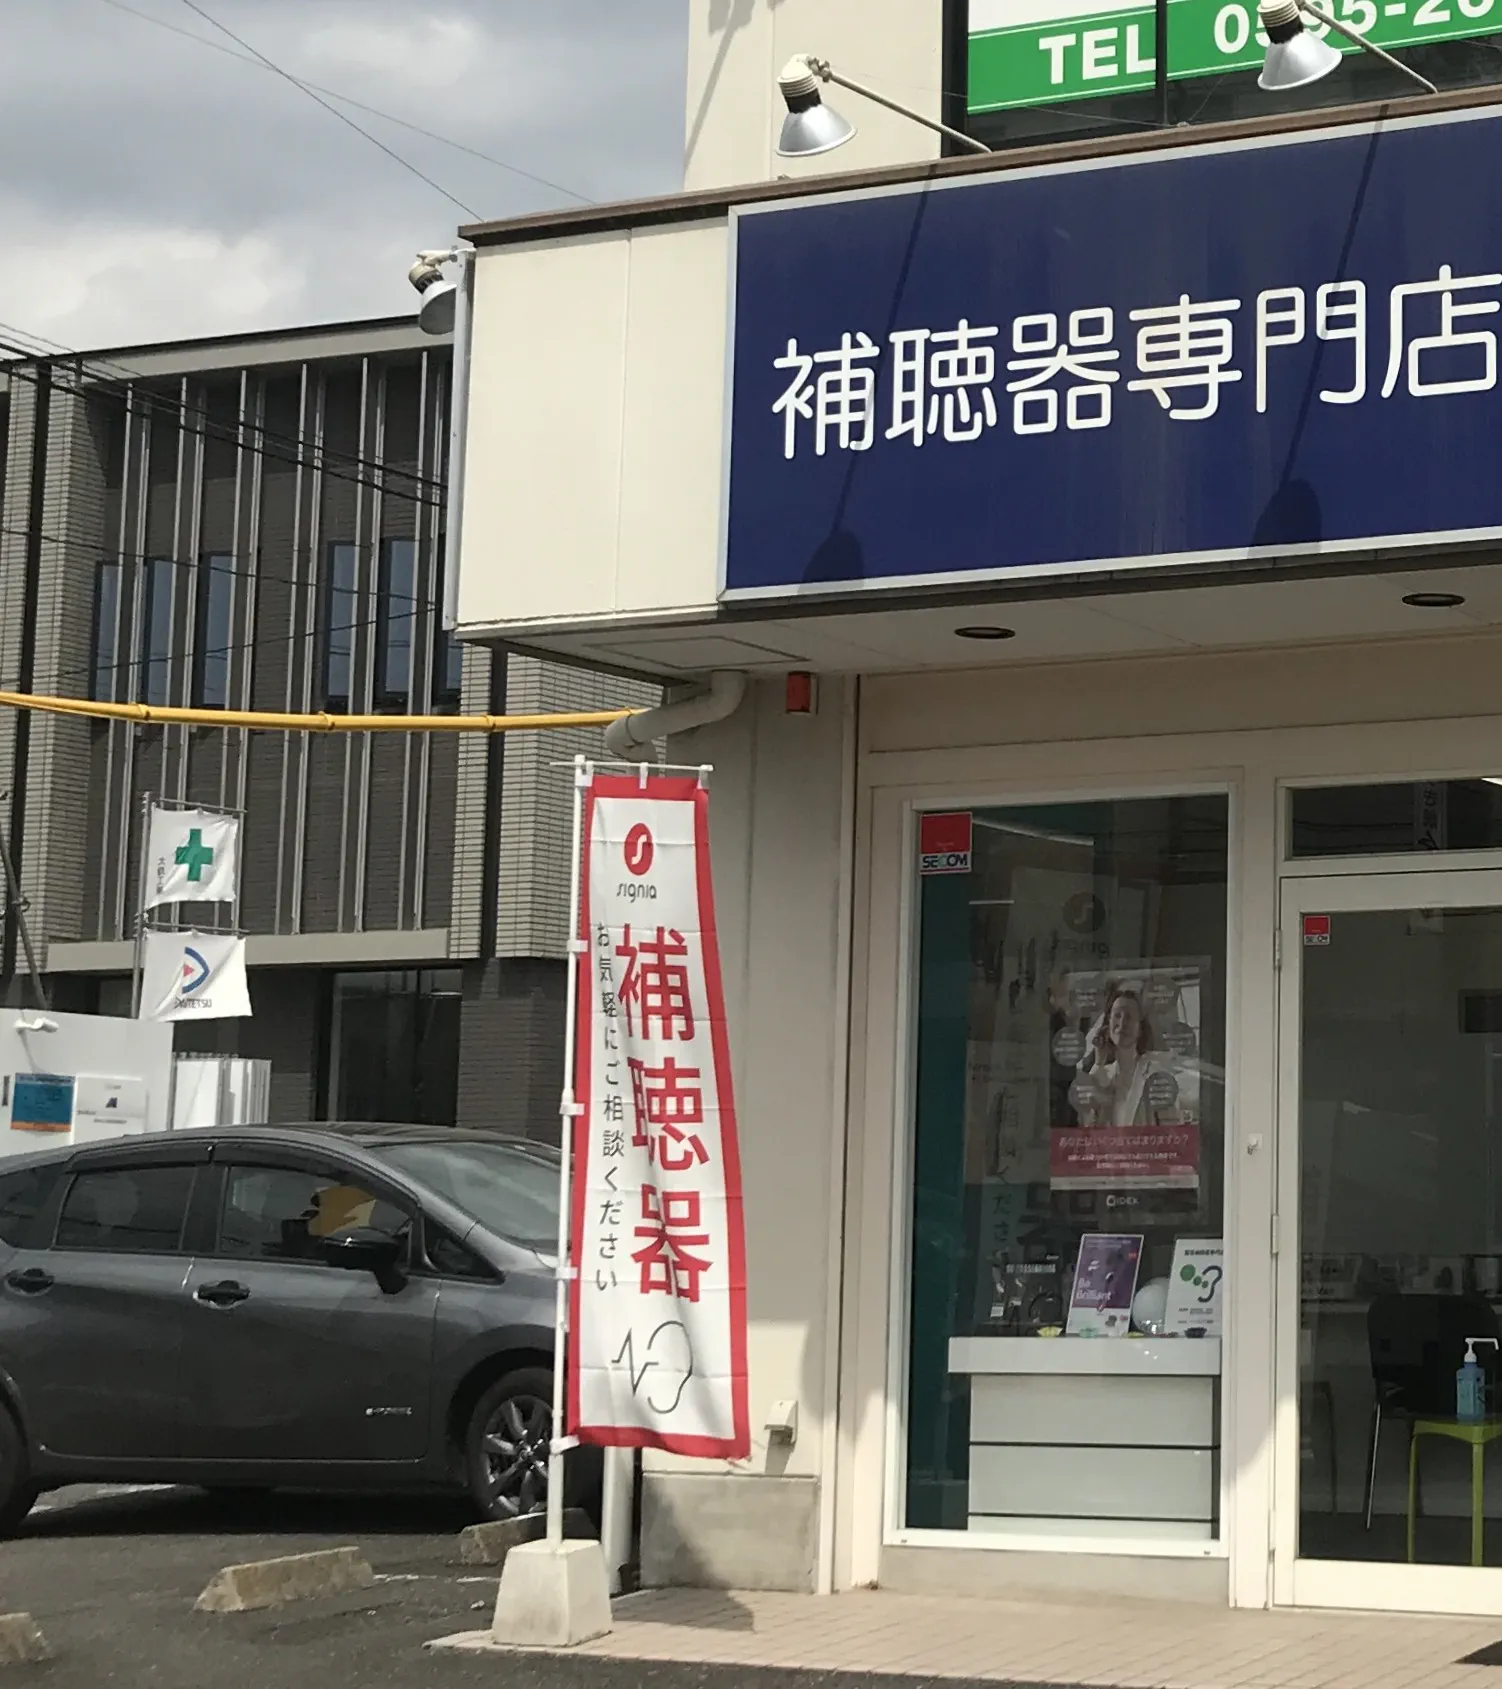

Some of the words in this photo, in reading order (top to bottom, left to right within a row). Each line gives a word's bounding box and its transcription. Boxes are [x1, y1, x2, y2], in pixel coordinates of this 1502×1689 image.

[1039, 24, 1156, 84] TEL
[772, 264, 1502, 458] 補聴器専門店
[616, 883, 657, 903] signia
[923, 854, 967, 868] SECOM
[596, 922, 625, 1291] お気軽にご相談ください
[616, 924, 713, 1302] 補聴器
